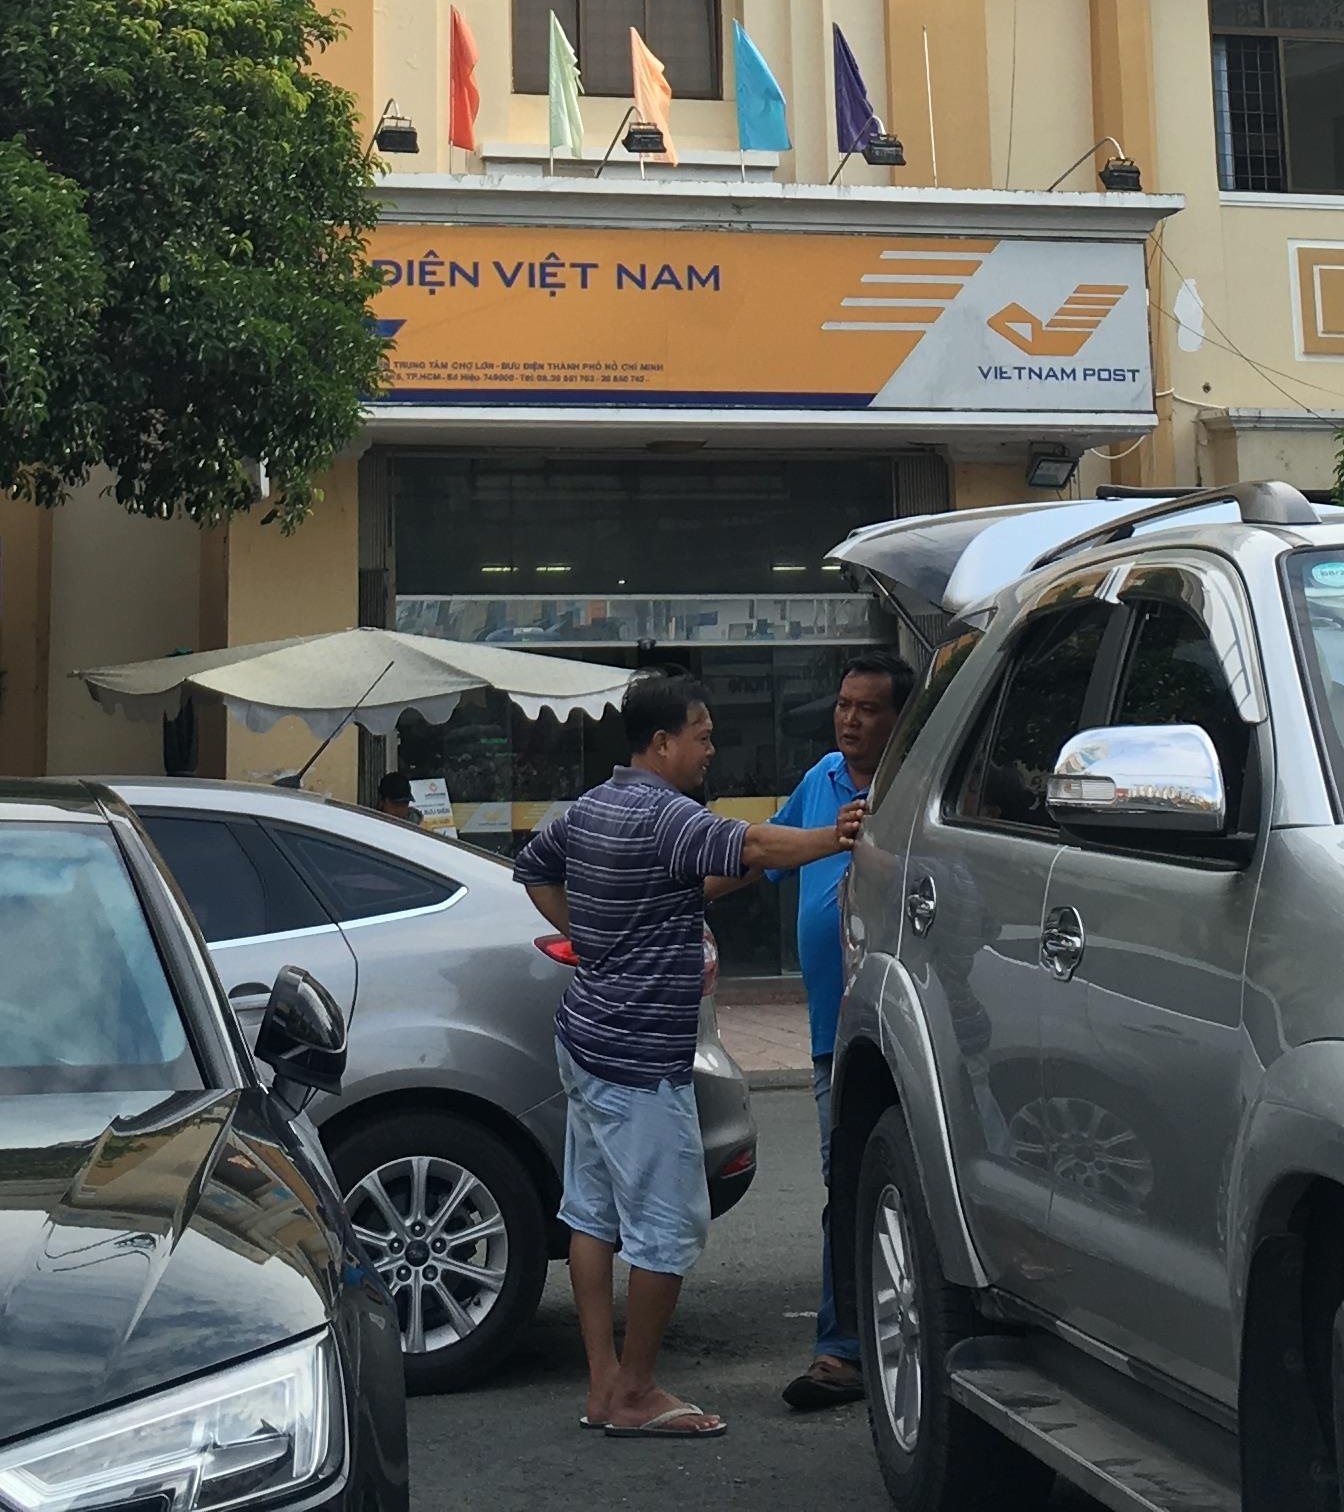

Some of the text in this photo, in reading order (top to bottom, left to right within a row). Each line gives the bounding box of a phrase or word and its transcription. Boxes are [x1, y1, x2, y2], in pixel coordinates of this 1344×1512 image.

[492, 252, 599, 298] VIỆT
[616, 262, 722, 292] NAM
[393, 361, 426, 370] TRUNG
[640, 363, 664, 372] MINH
[978, 366, 1140, 383] VIETNAM POST
